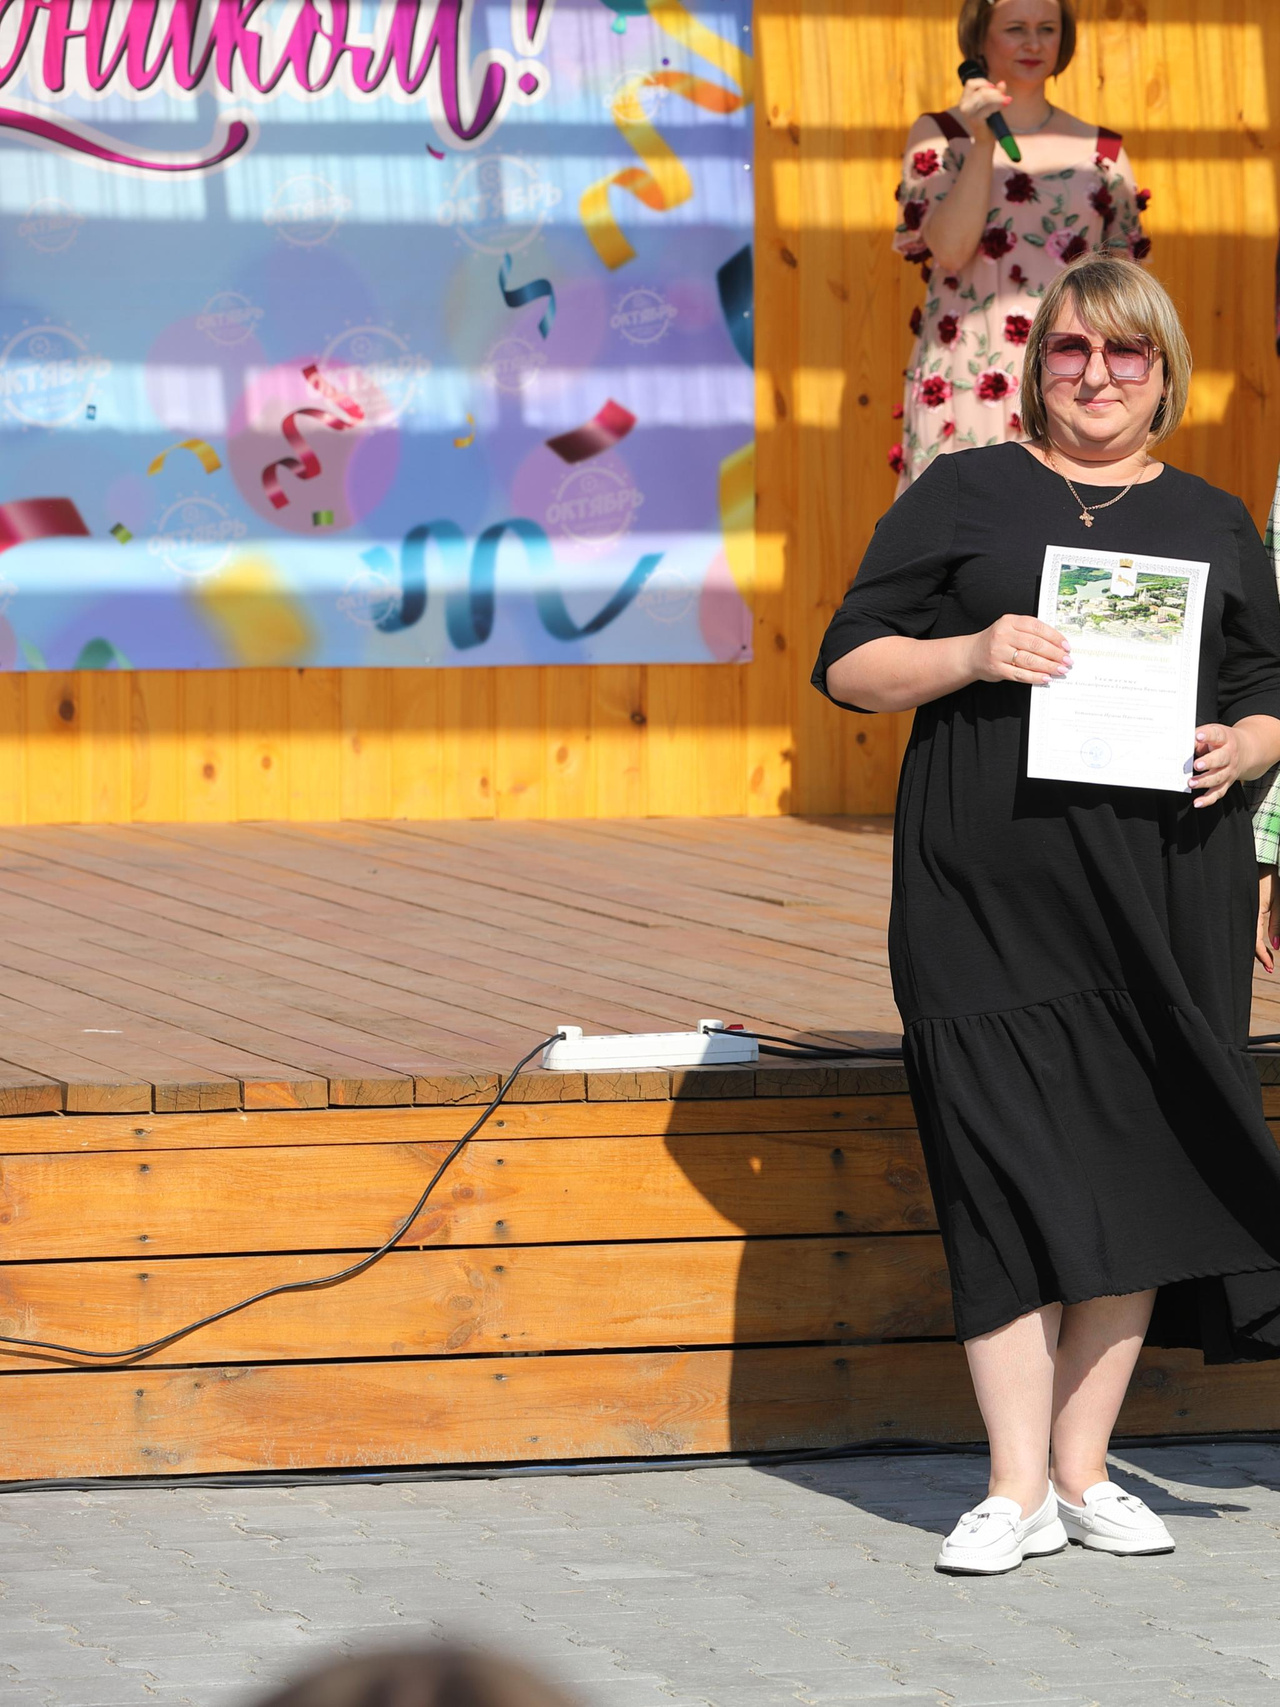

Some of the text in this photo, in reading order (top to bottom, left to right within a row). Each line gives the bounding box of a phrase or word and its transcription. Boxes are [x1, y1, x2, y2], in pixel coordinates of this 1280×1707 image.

[0, 0, 540, 140] ником!
[437, 182, 562, 228] ОКТЯБРЬ
[546, 487, 644, 525] ОКТЯБРЬ
[148, 518, 248, 556] ОКТЯБРЬ
